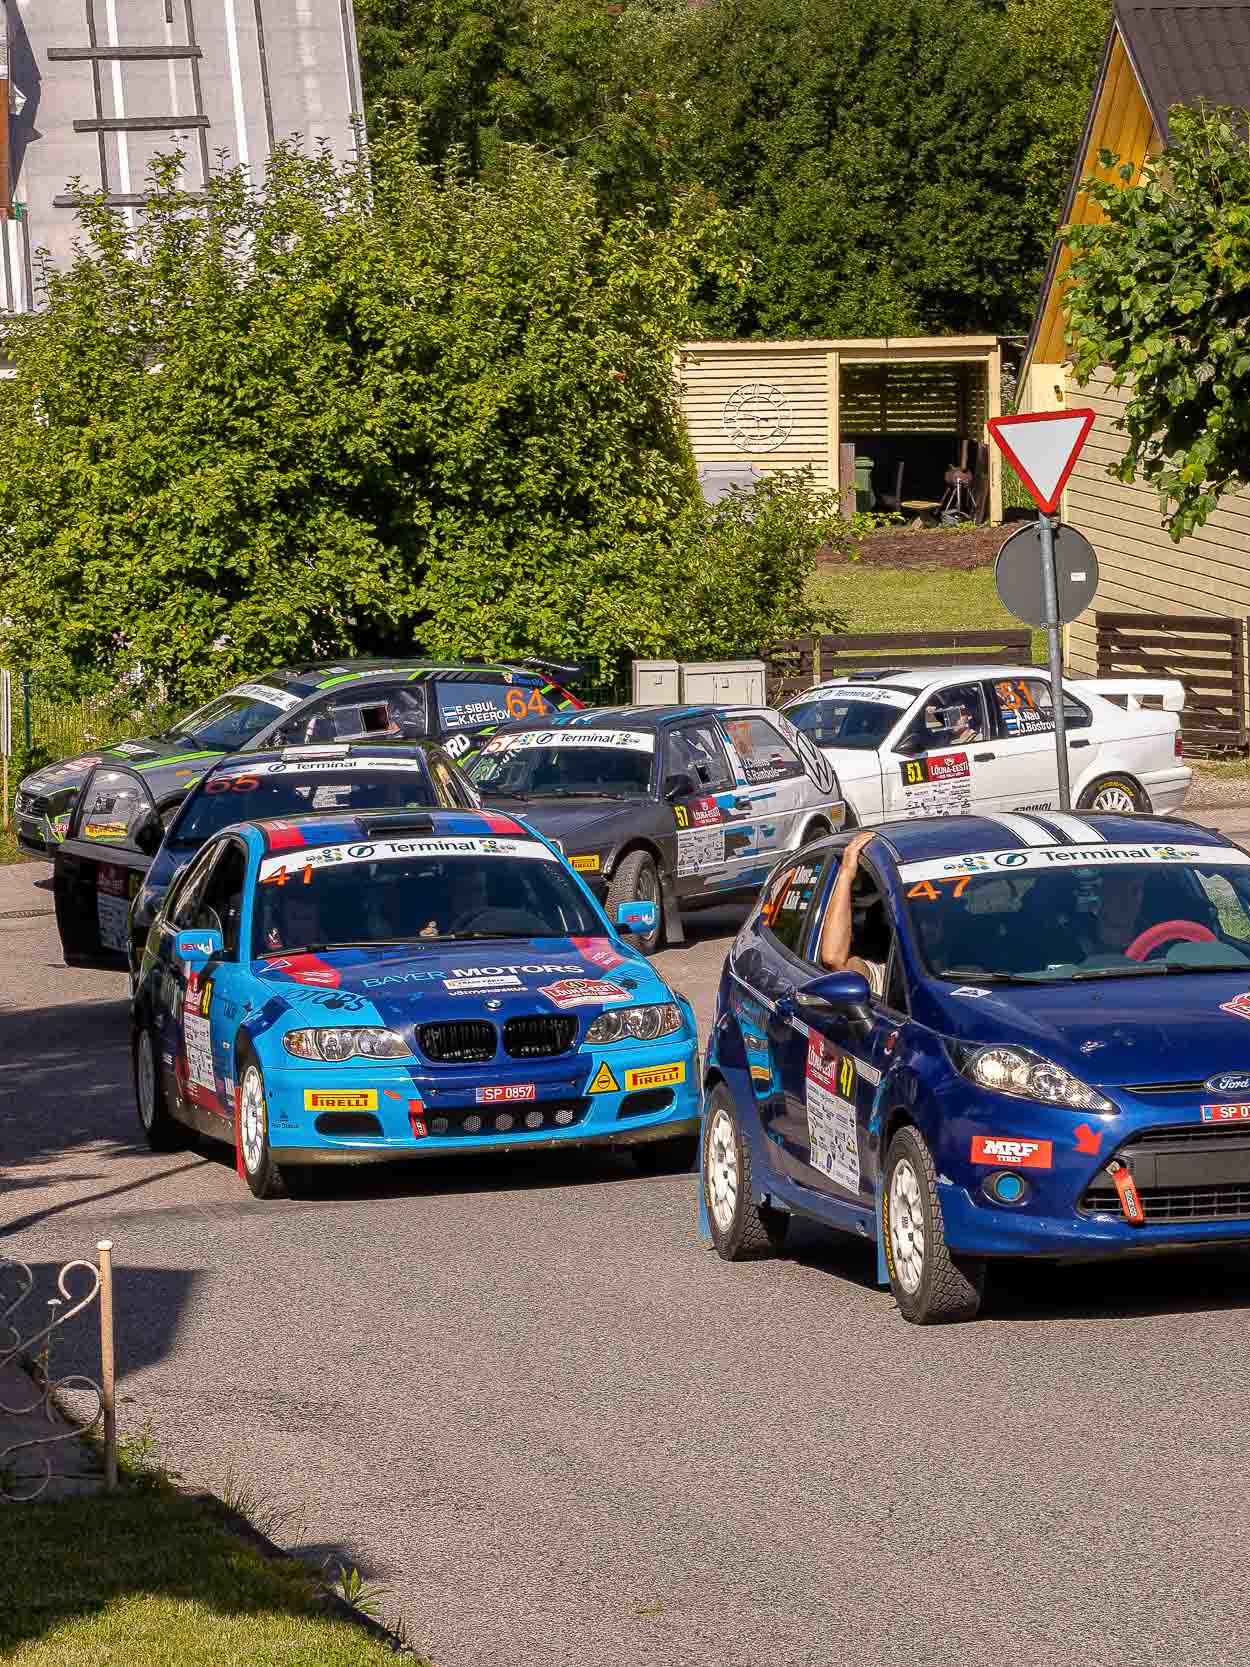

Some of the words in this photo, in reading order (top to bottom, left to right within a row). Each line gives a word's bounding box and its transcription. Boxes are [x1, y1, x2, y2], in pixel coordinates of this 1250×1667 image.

[456, 701, 497, 714] E.SIBUL
[505, 687, 547, 718] 64
[459, 710, 511, 725] K.KEEROV
[559, 733, 614, 743] Terminal
[296, 760, 357, 770] Terminal
[906, 762, 923, 783] 51
[205, 774, 260, 794] 65
[674, 806, 689, 827] 57
[385, 840, 475, 853] Terminal
[1039, 847, 1151, 862] Terminal
[262, 864, 313, 886] 41
[906, 876, 973, 900] 47
[362, 970, 447, 988] BAYER
[452, 964, 585, 979] MOTORS
[632, 1066, 679, 1086] PIRELLI
[840, 1056, 853, 1097] 47
[1219, 1075, 1250, 1090] Ford
[312, 1093, 369, 1107] PIRELLI
[484, 1087, 502, 1100] SP
[505, 1085, 532, 1098] 0857
[1220, 1106, 1237, 1118] SP
[983, 1139, 1038, 1157] MRF
